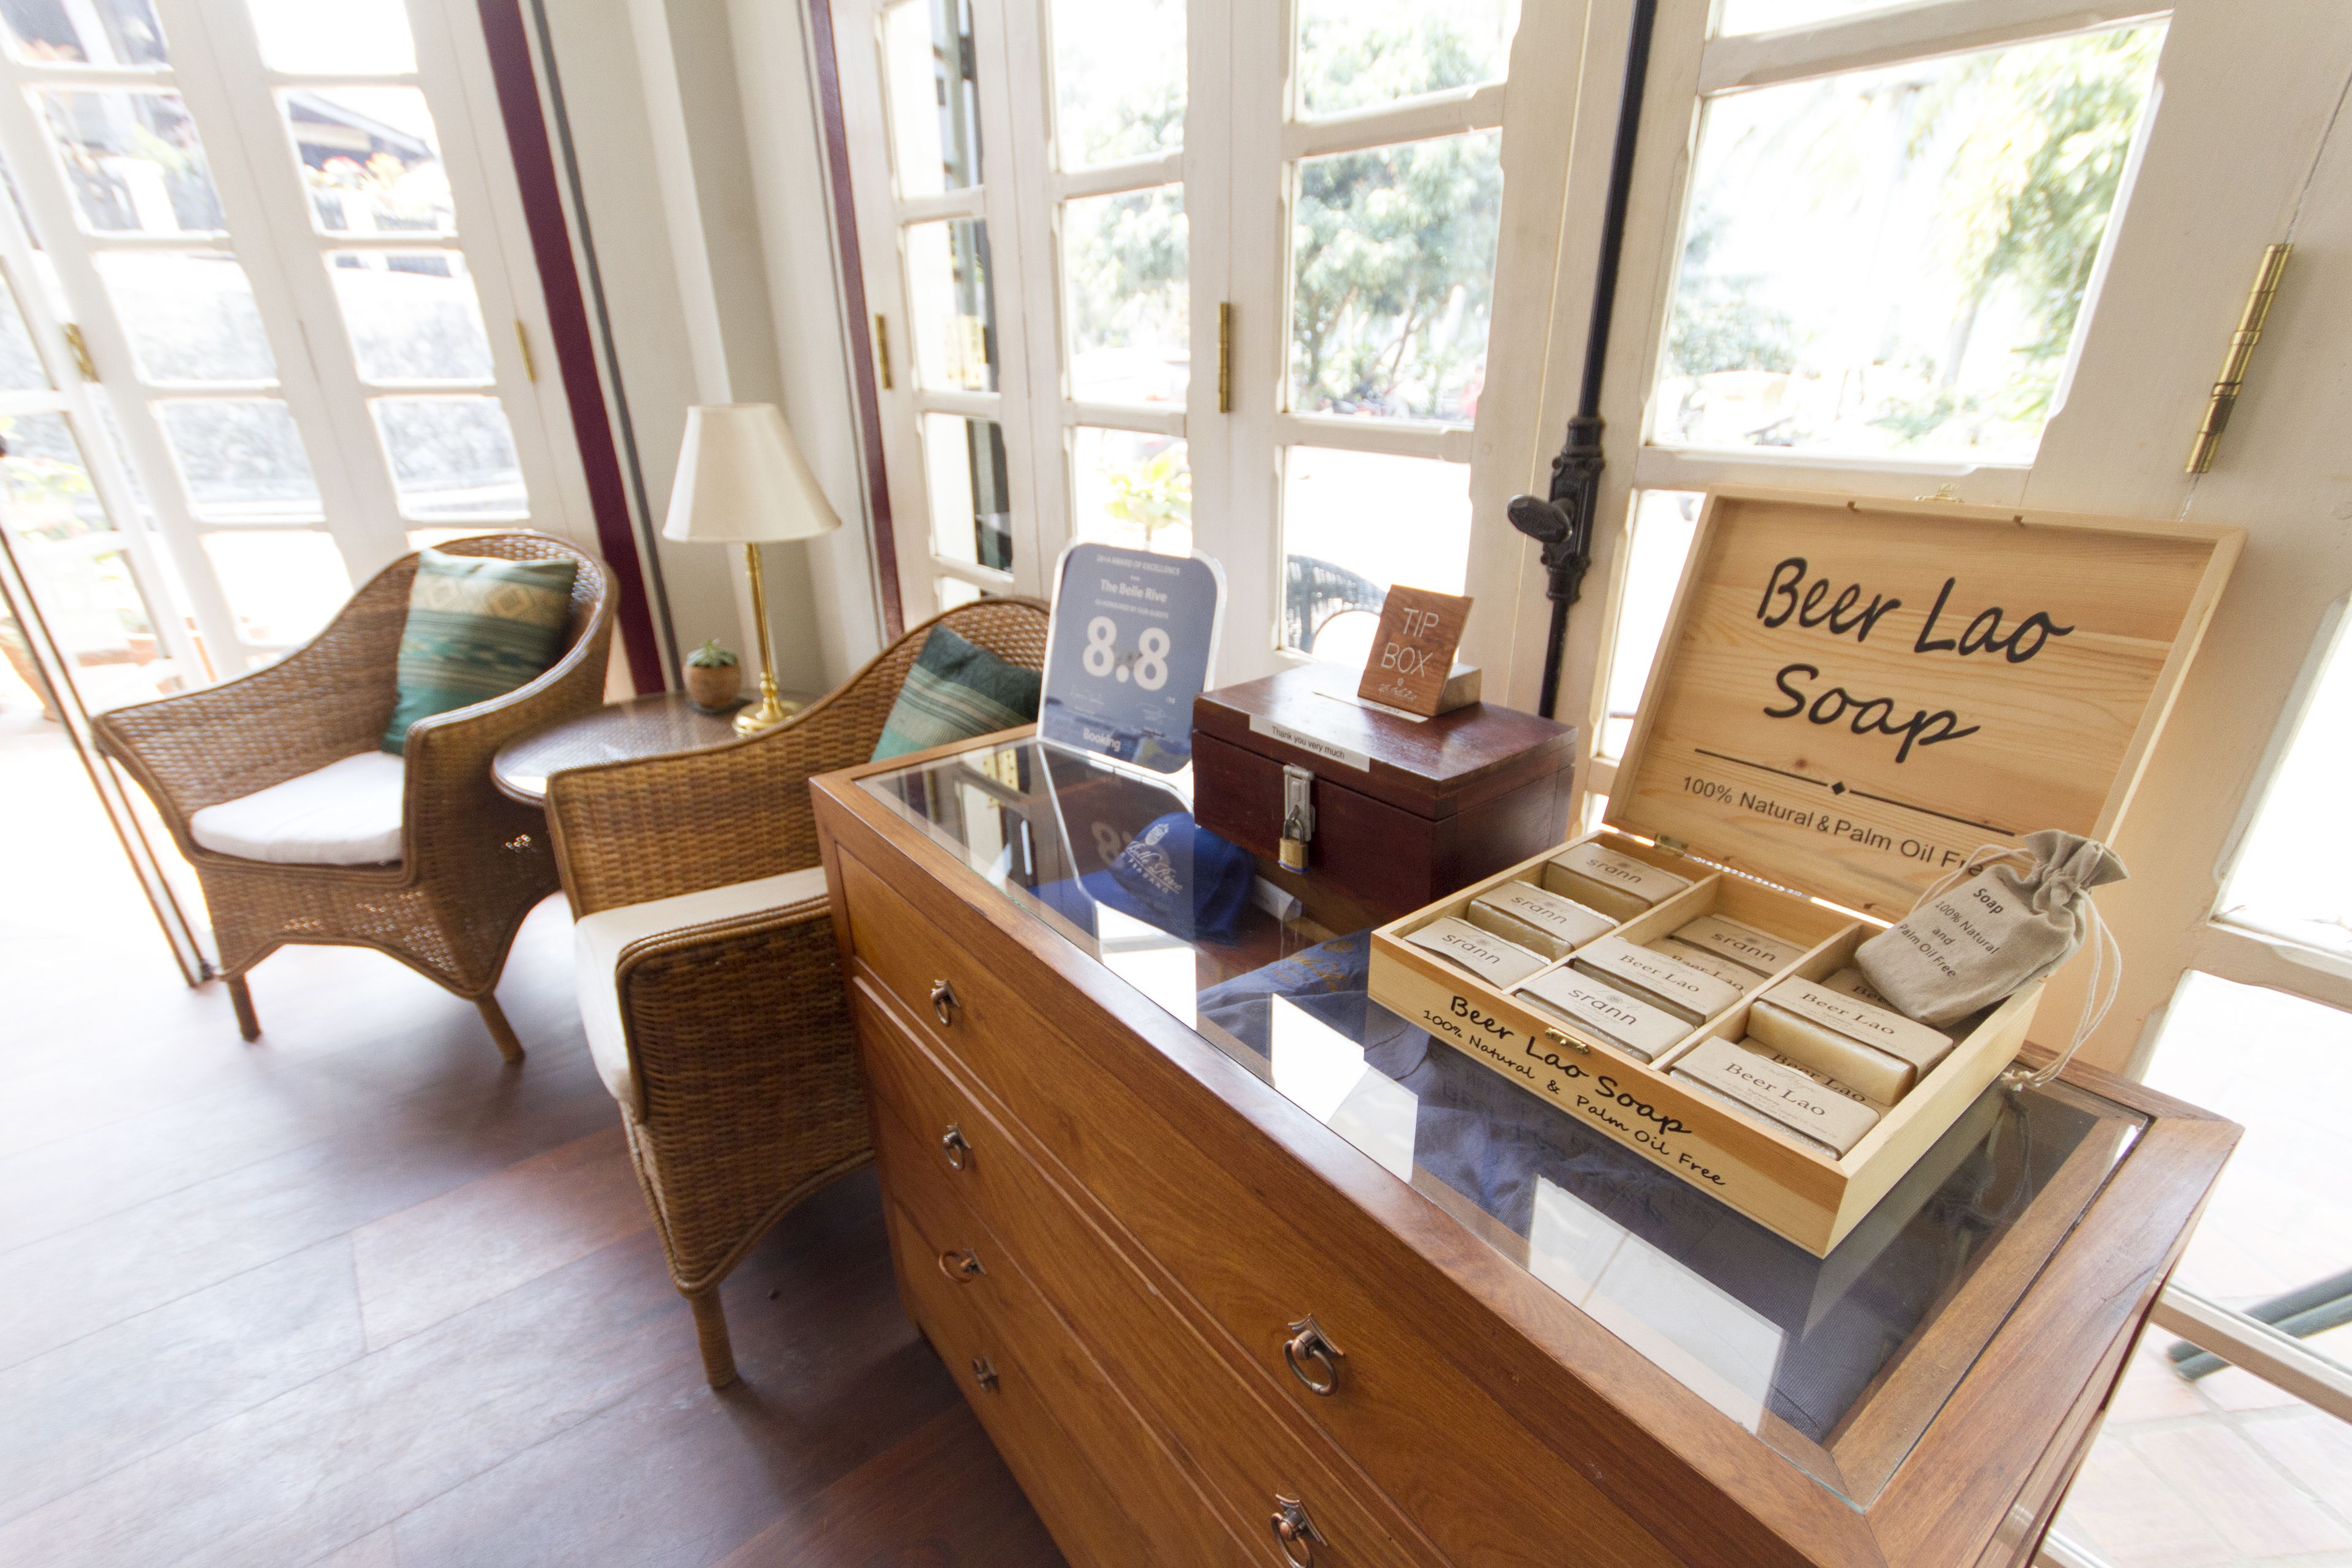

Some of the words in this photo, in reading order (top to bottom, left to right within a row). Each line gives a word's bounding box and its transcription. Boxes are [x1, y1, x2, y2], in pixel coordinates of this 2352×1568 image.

[1142, 562, 1181, 575] EXCELLENCE
[1101, 578, 1118, 593] The
[1119, 582, 1144, 598] Belle
[1145, 587, 1167, 603] Rive
[1403, 607, 1439, 638] TIP
[1756, 557, 1902, 642] Beer
[1914, 577, 2075, 663] Lao
[1083, 616, 1170, 691] 8.8
[1381, 642, 1433, 677] BOX
[1763, 663, 1981, 763] Soap
[1084, 728, 1121, 753] Booking
[1272, 726, 1292, 740] Thank
[1294, 735, 1307, 745] you
[1308, 740, 1324, 752] very
[1324, 746, 1345, 760] much
[1683, 776, 1733, 804] 100%
[1739, 792, 1815, 828] Natural
[1817, 815, 1830, 832] &
[1834, 820, 1892, 851] Palm
[1901, 839, 1935, 863] Oil
[1586, 859, 1642, 883] srann
[1510, 896, 1567, 924] srann
[1973, 888, 2003, 914] Soap
[1932, 928, 1956, 946] and
[1936, 901, 1962, 923] 100%
[1959, 921, 2000, 954] Natural
[1442, 934, 1501, 964] srann
[1711, 933, 1776, 962] srann
[1899, 924, 1921, 944] Palm
[1919, 943, 1939, 958] Oil
[1933, 956, 1956, 977] Free
[1619, 954, 1662, 976] Beer
[1664, 973, 1700, 993] Lao
[1567, 989, 1637, 1025] srann
[1852, 986, 1890, 1005] Bee
[1800, 993, 1850, 1015] Beer
[1853, 1014, 1895, 1035] Lao
[1450, 995, 1515, 1040] Beer
[1525, 1036, 1590, 1079] Lao
[1595, 1076, 1692, 1135] Soap
[1423, 1009, 1463, 1039] 100%
[1469, 1035, 1536, 1079] Natural
[1547, 1080, 1561, 1095] &
[1577, 1095, 1629, 1131] Palm
[1634, 1131, 1670, 1155] Oil
[1679, 1153, 1727, 1186] Free
[1724, 1062, 1777, 1091] Beer
[1779, 1088, 1826, 1116] Lao
[1823, 1078, 1866, 1102] Lao
